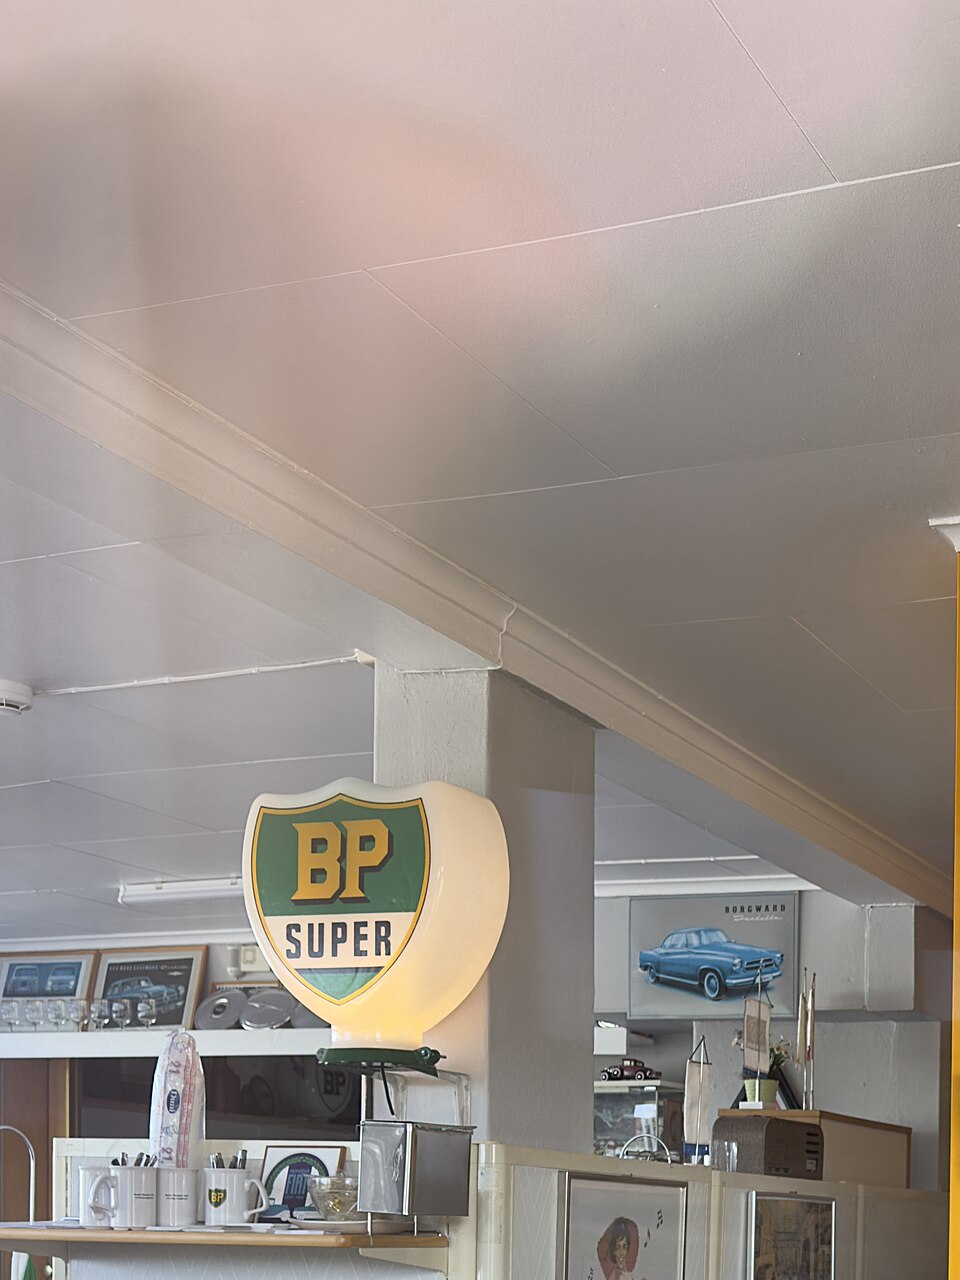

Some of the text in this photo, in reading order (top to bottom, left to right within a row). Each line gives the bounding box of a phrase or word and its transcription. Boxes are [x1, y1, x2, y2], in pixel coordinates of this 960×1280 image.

[291, 819, 393, 905] BP
[725, 904, 786, 914] BORGWARD
[285, 920, 392, 959] SUPER
[323, 1070, 346, 1096] BP
[211, 1192, 224, 1202] BP
